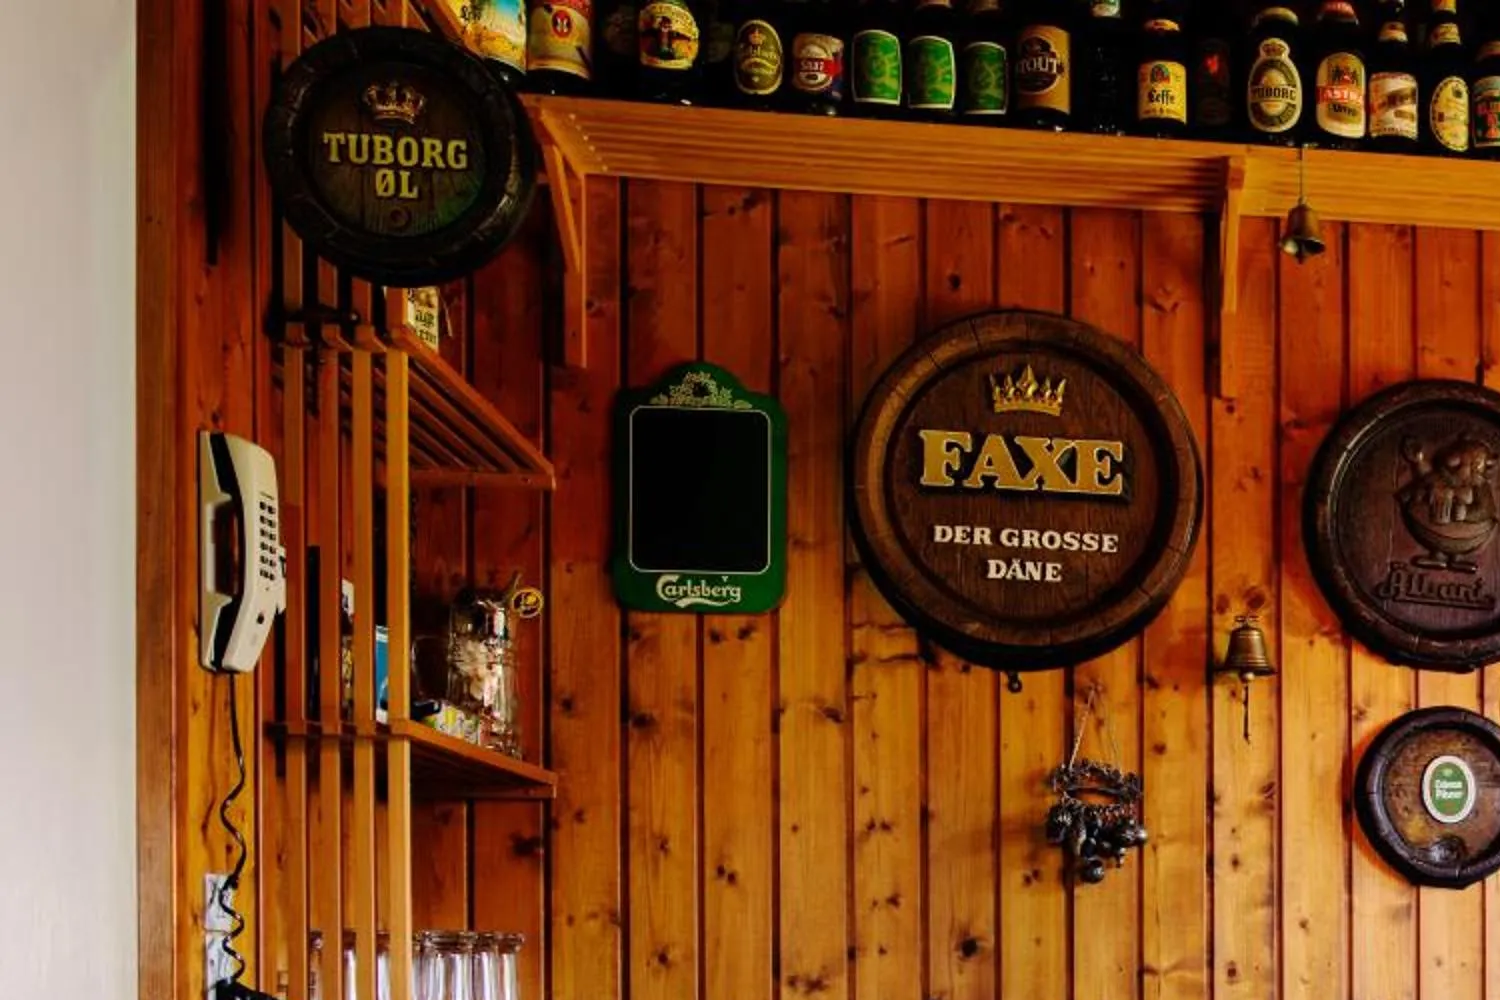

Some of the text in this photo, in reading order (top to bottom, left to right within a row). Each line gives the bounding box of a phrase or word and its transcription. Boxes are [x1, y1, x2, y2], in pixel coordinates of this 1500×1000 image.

[1016, 56, 1058, 74] TOUT
[323, 132, 468, 169] TUBORG
[375, 168, 418, 198] ØL
[919, 430, 1123, 495] FAXE
[933, 524, 1119, 553] DER GROSSE
[987, 559, 1062, 582] DÄNE
[656, 574, 742, 608] Carlsberg
